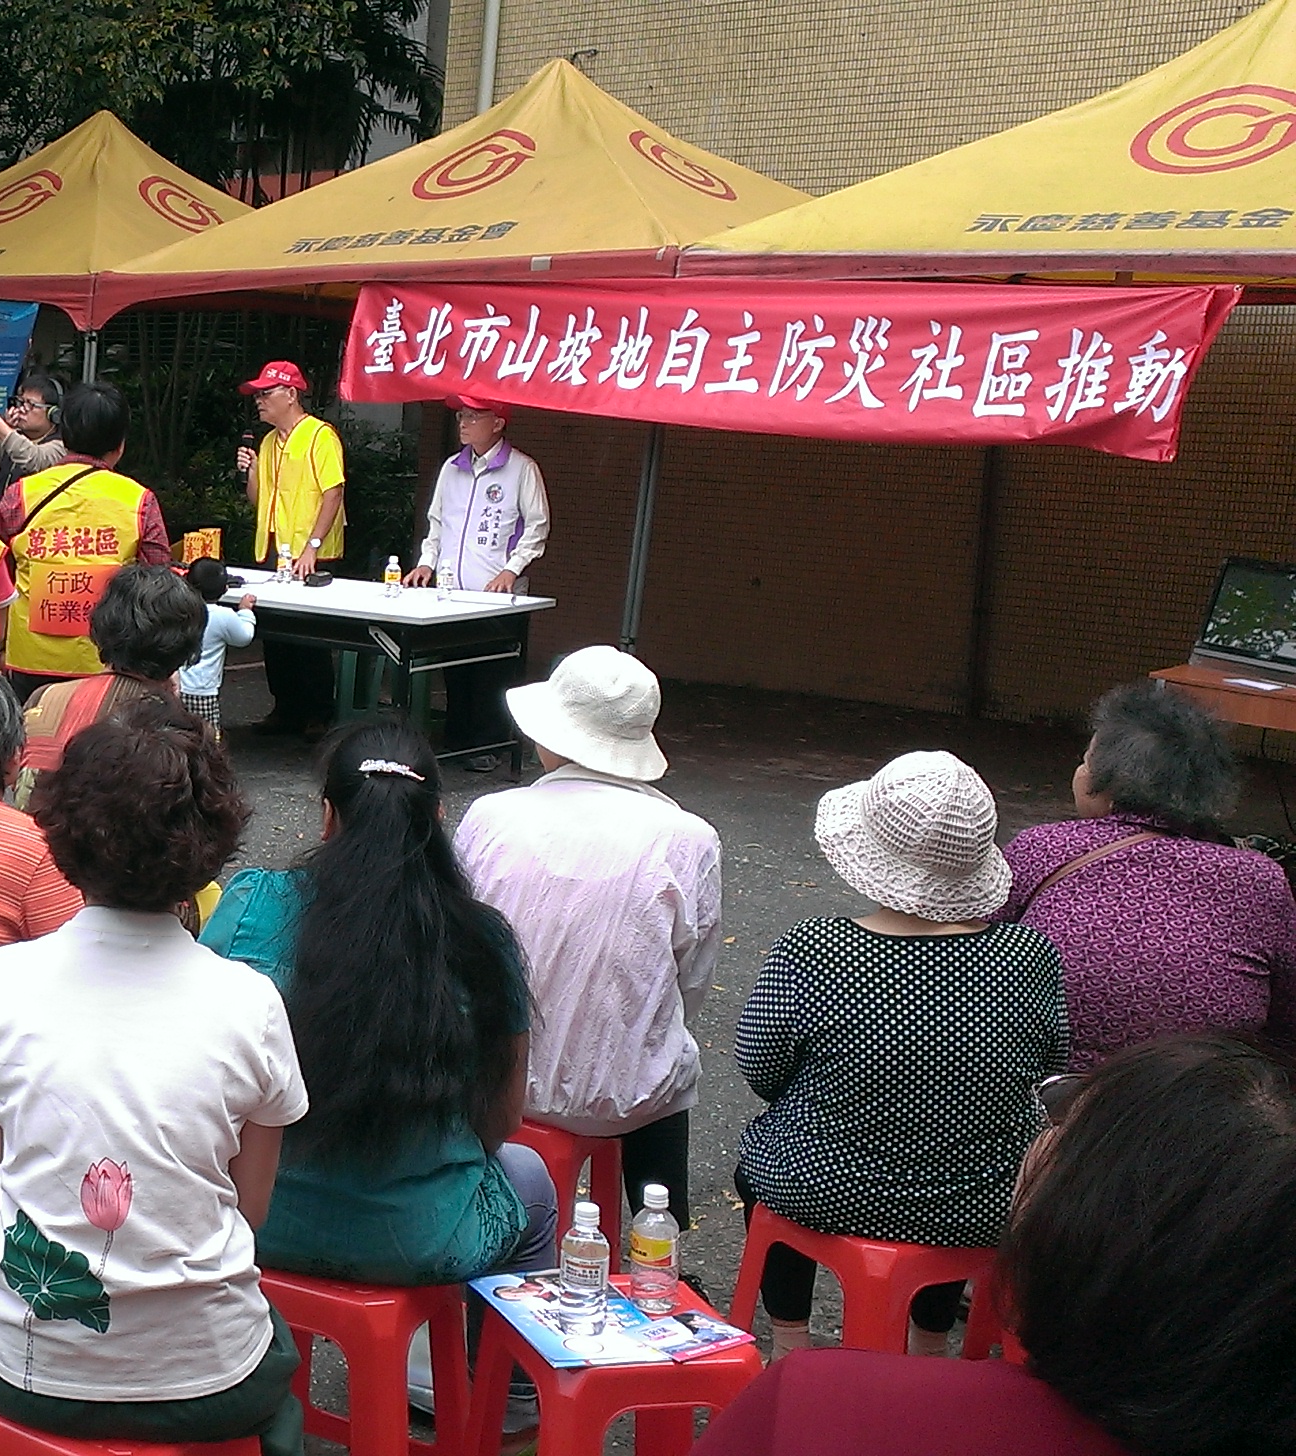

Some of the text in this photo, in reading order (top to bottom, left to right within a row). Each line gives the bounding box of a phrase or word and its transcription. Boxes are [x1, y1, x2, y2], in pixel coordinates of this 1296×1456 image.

[364, 296, 1189, 424] 臺北市山坡地自主防災社區推動
[25, 525, 120, 560] 萬美社區
[46, 570, 95, 595] 行政
